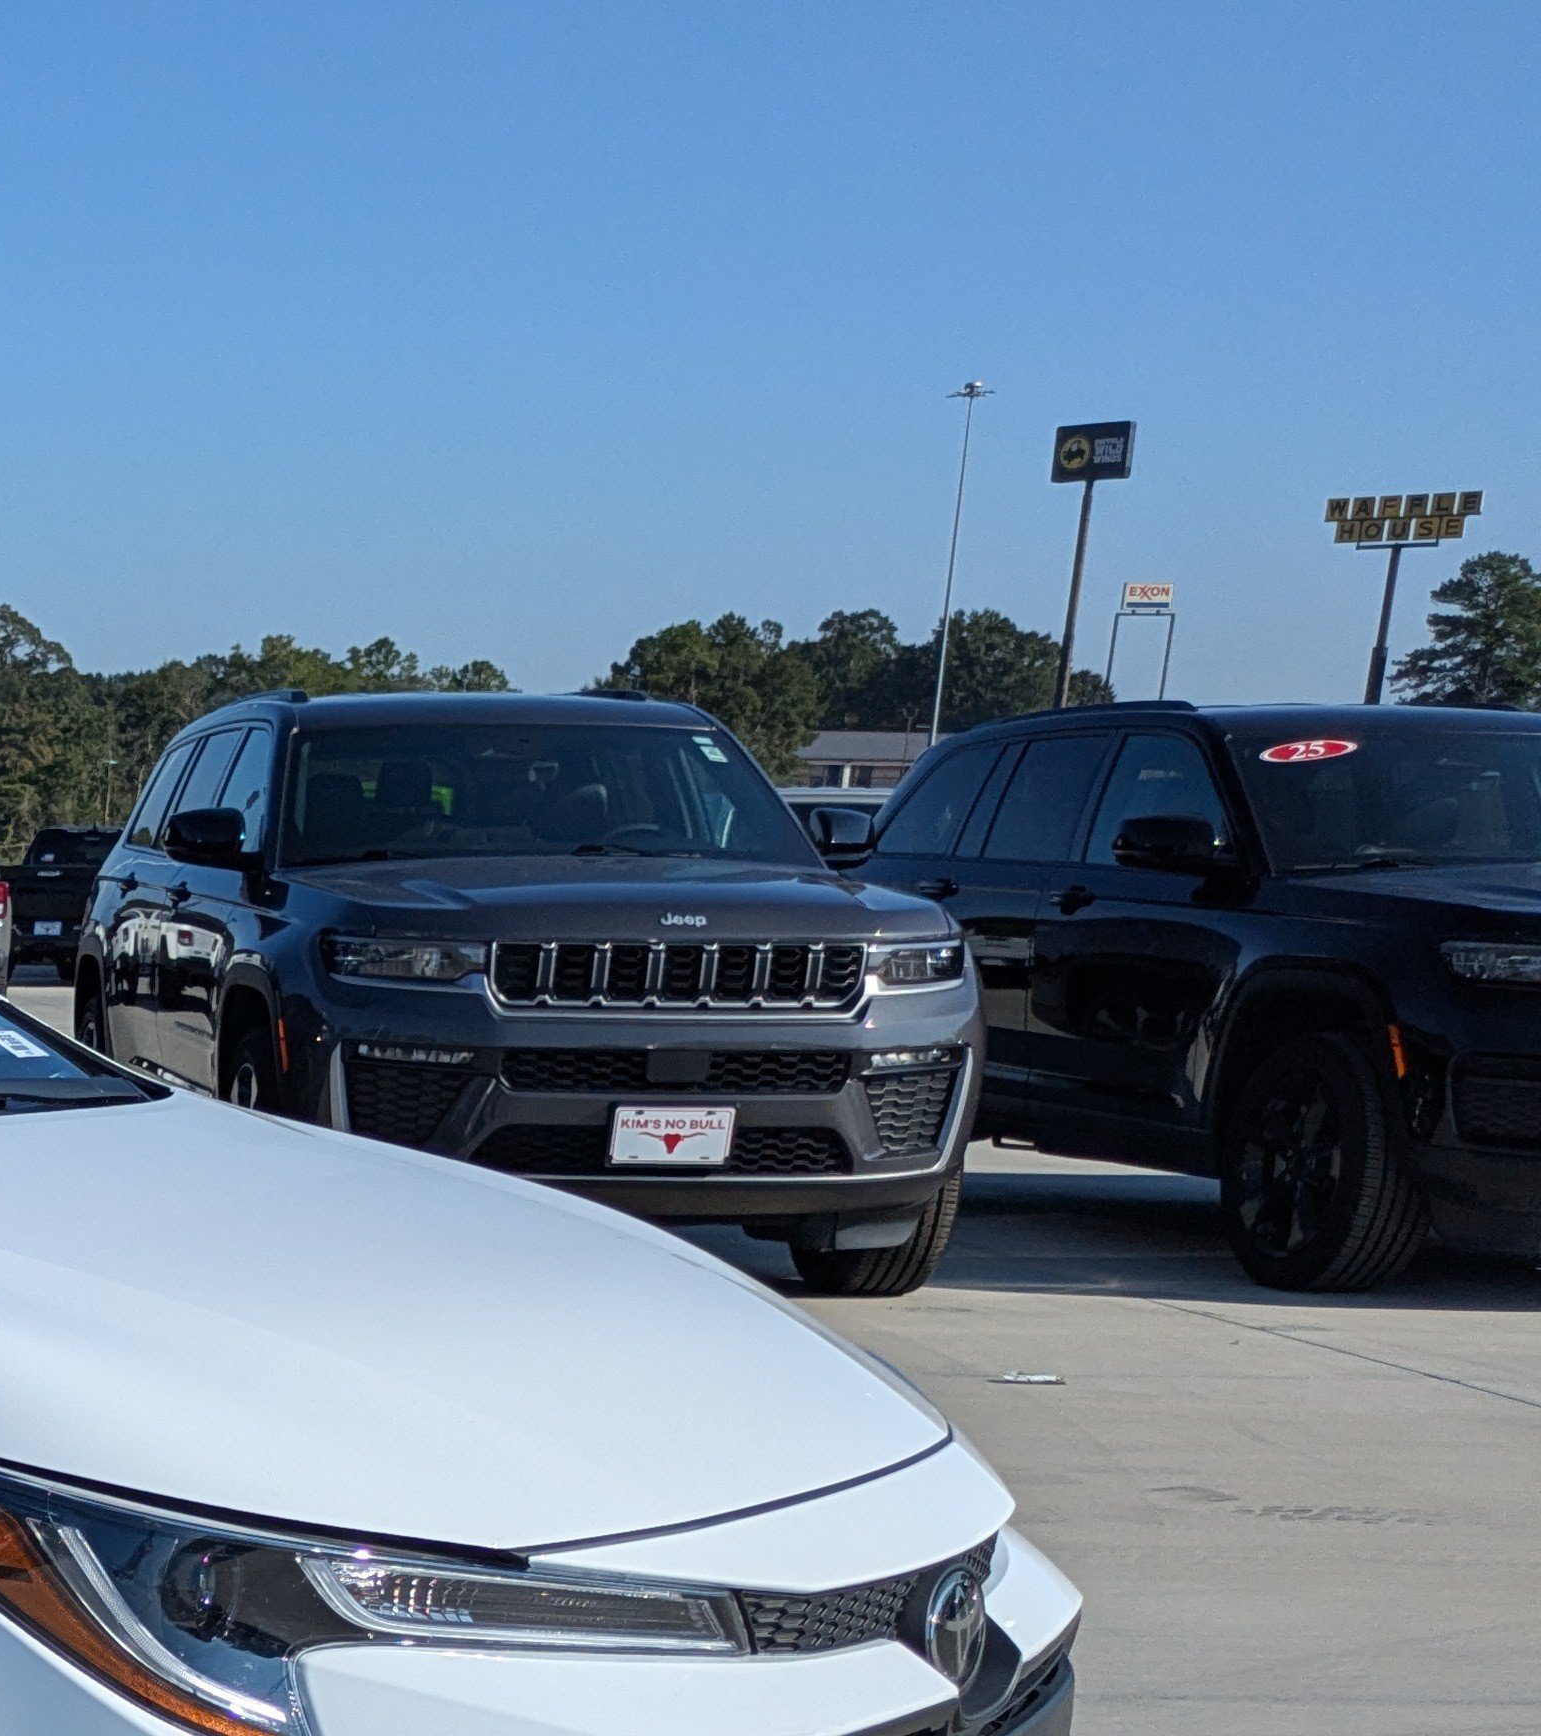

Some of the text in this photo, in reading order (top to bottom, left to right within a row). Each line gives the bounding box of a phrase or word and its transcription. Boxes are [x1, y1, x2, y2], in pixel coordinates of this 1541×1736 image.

[1328, 494, 1478, 517] WAFFLE
[1340, 518, 1461, 541] HOUSE
[1129, 585, 1171, 600] EXXON
[1288, 740, 1326, 760] 25
[660, 911, 707, 928] Jeep
[620, 1119, 725, 1130] KIM'S NO BULL
